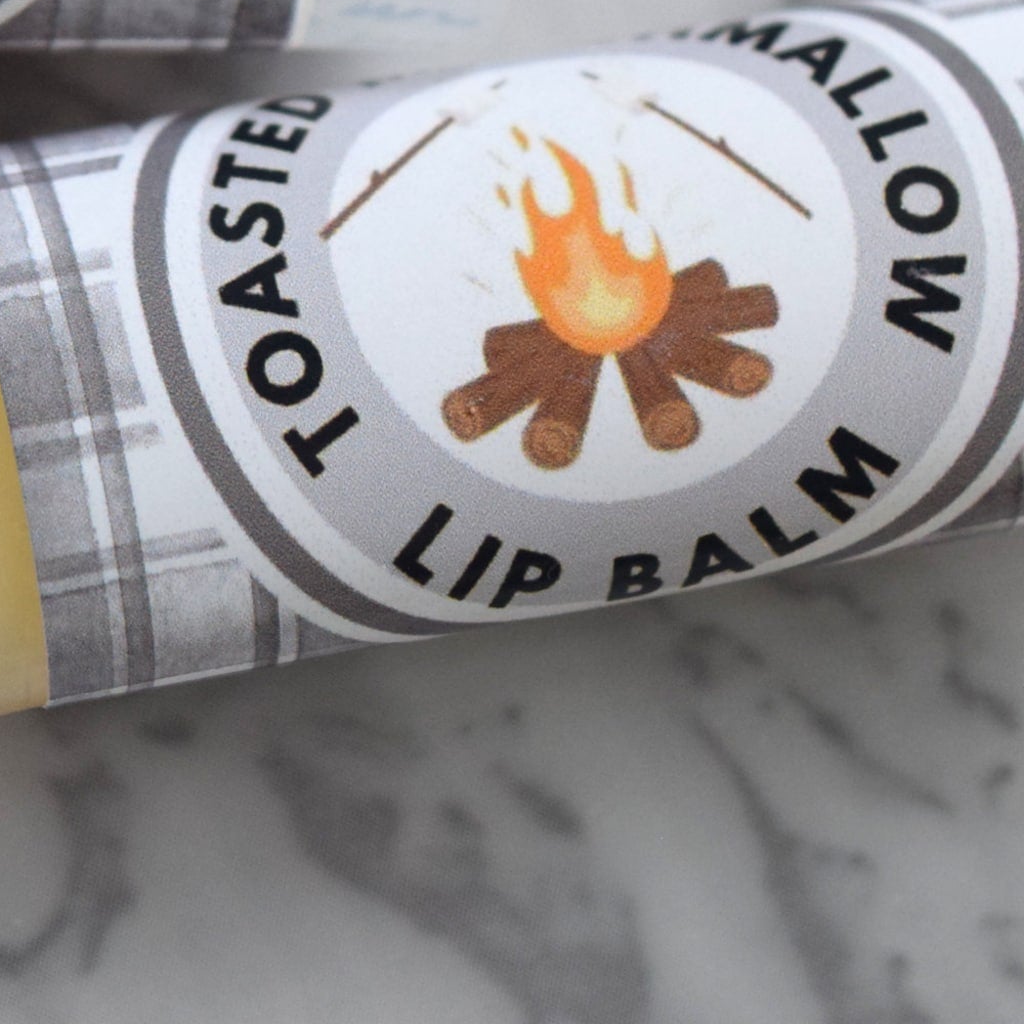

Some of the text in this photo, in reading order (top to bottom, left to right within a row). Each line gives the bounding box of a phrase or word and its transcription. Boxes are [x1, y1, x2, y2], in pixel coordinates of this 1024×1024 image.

[208, 94, 333, 479] TOASTED
[391, 425, 901, 610] LIP BALM
